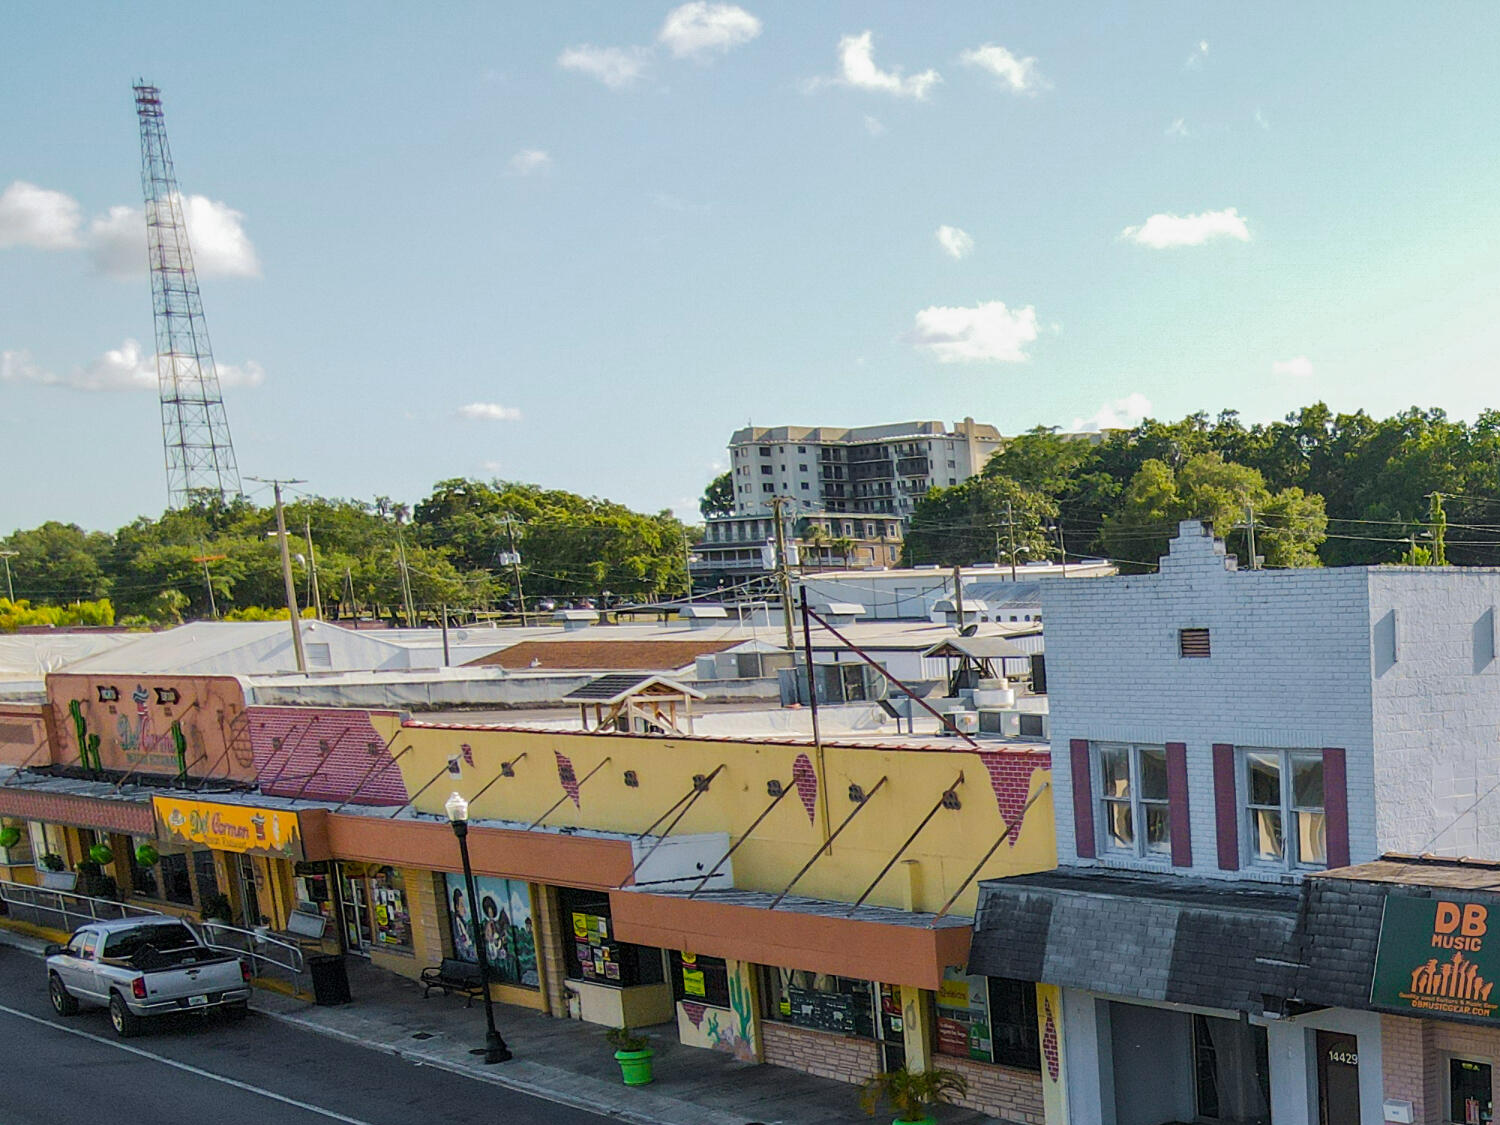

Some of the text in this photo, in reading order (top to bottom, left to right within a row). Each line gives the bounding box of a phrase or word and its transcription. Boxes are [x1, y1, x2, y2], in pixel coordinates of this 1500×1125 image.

[1434, 901, 1488, 936] DB
[1431, 934, 1482, 952] MUSIC
[1411, 1000, 1490, 1016] DBMUSICGEAR.COM
[1328, 1050, 1358, 1065] 14429
